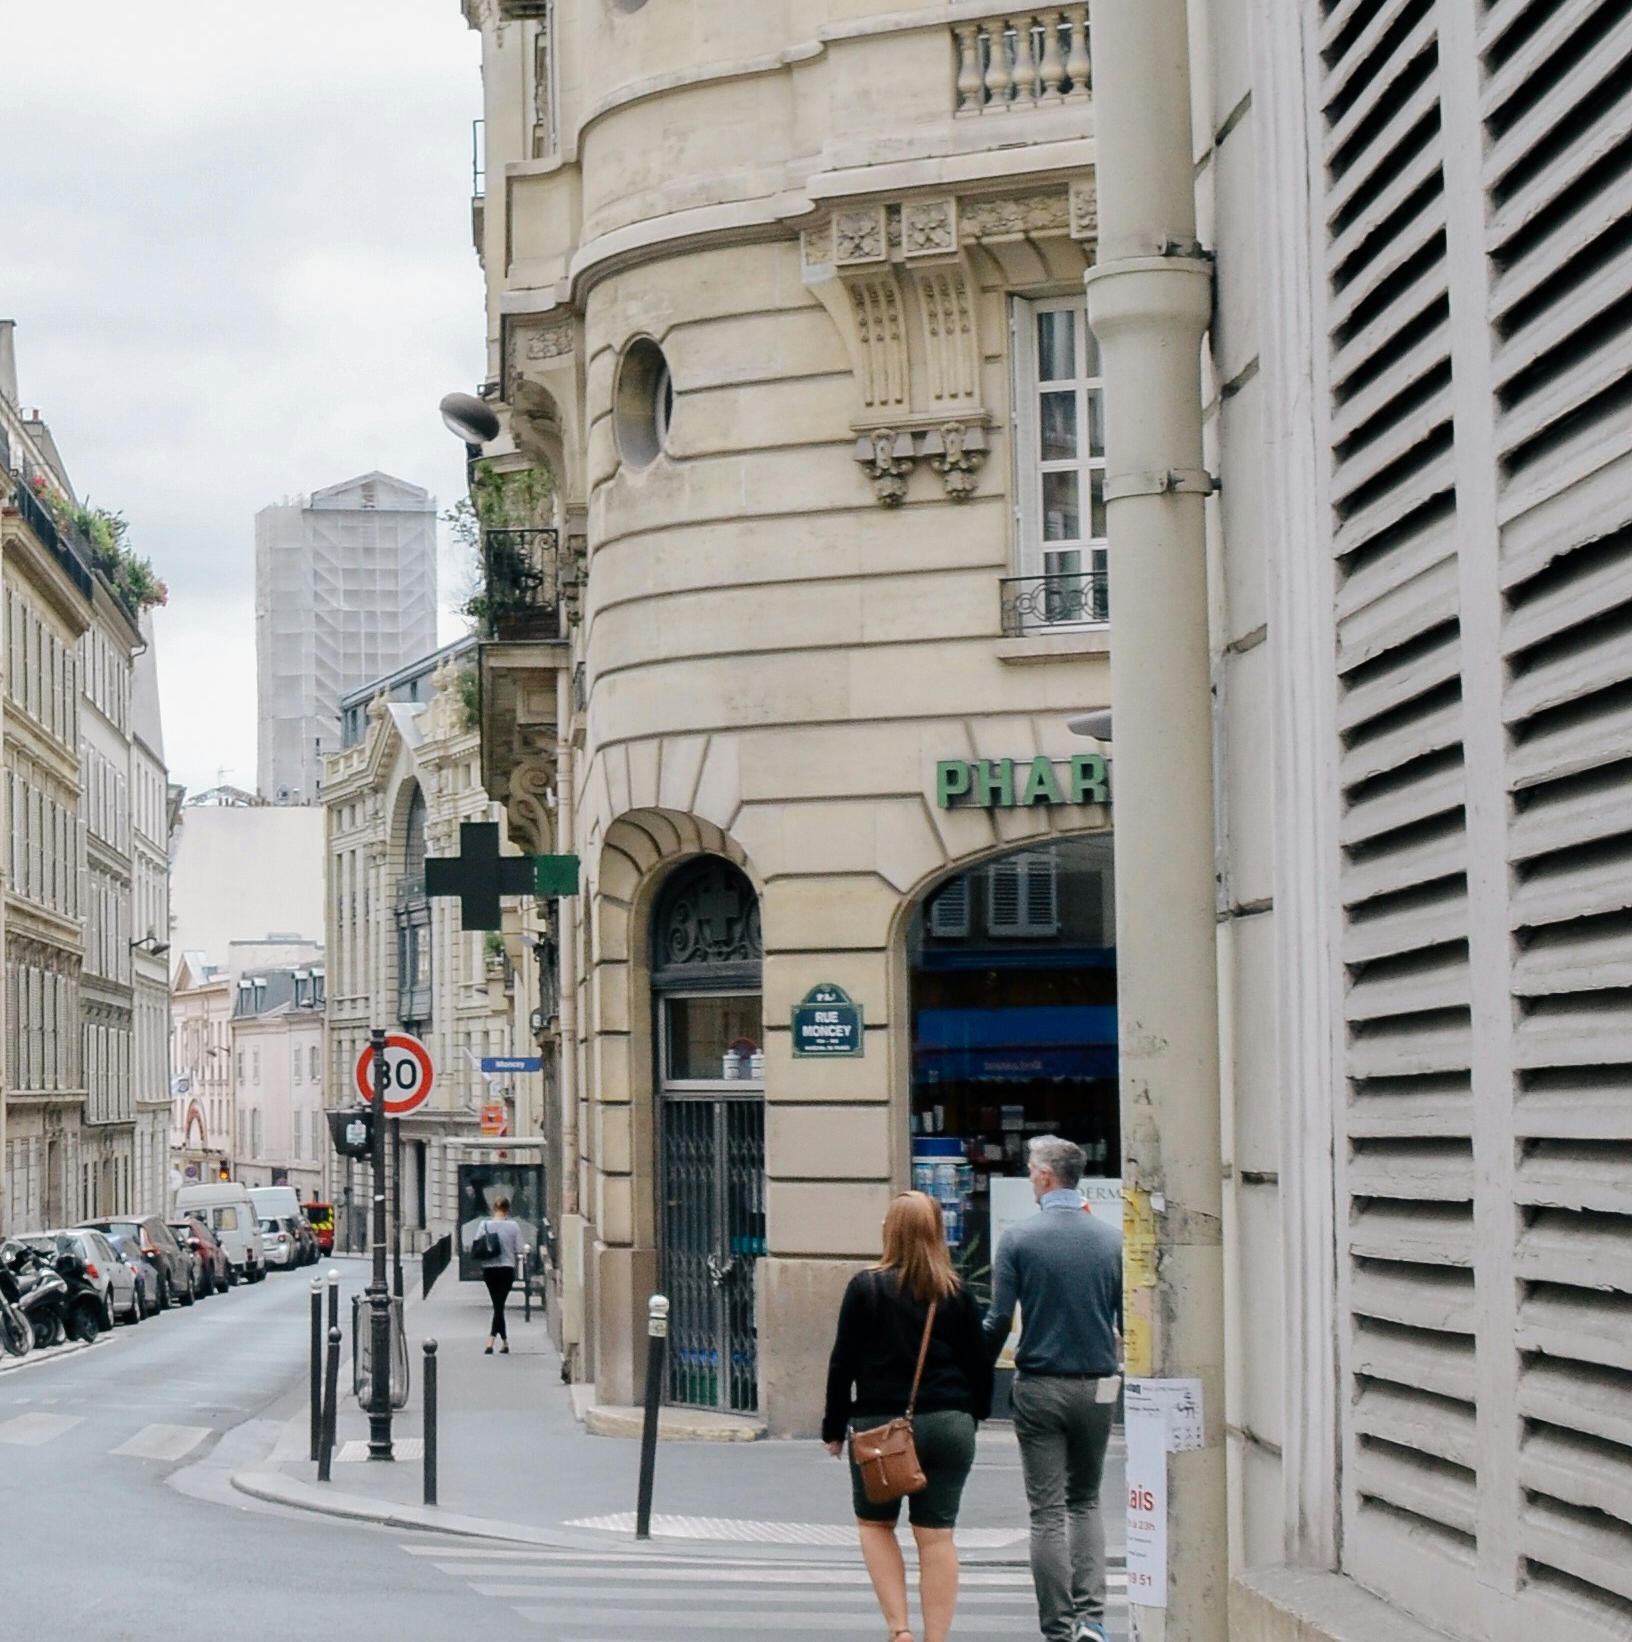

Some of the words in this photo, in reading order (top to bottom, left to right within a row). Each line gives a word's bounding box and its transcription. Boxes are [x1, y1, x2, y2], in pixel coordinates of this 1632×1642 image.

[937, 753, 1110, 808] PHAR
[815, 1011, 839, 1023] RUE
[802, 1024, 852, 1037] MONCEY
[1139, 1574, 1153, 1587] 51
